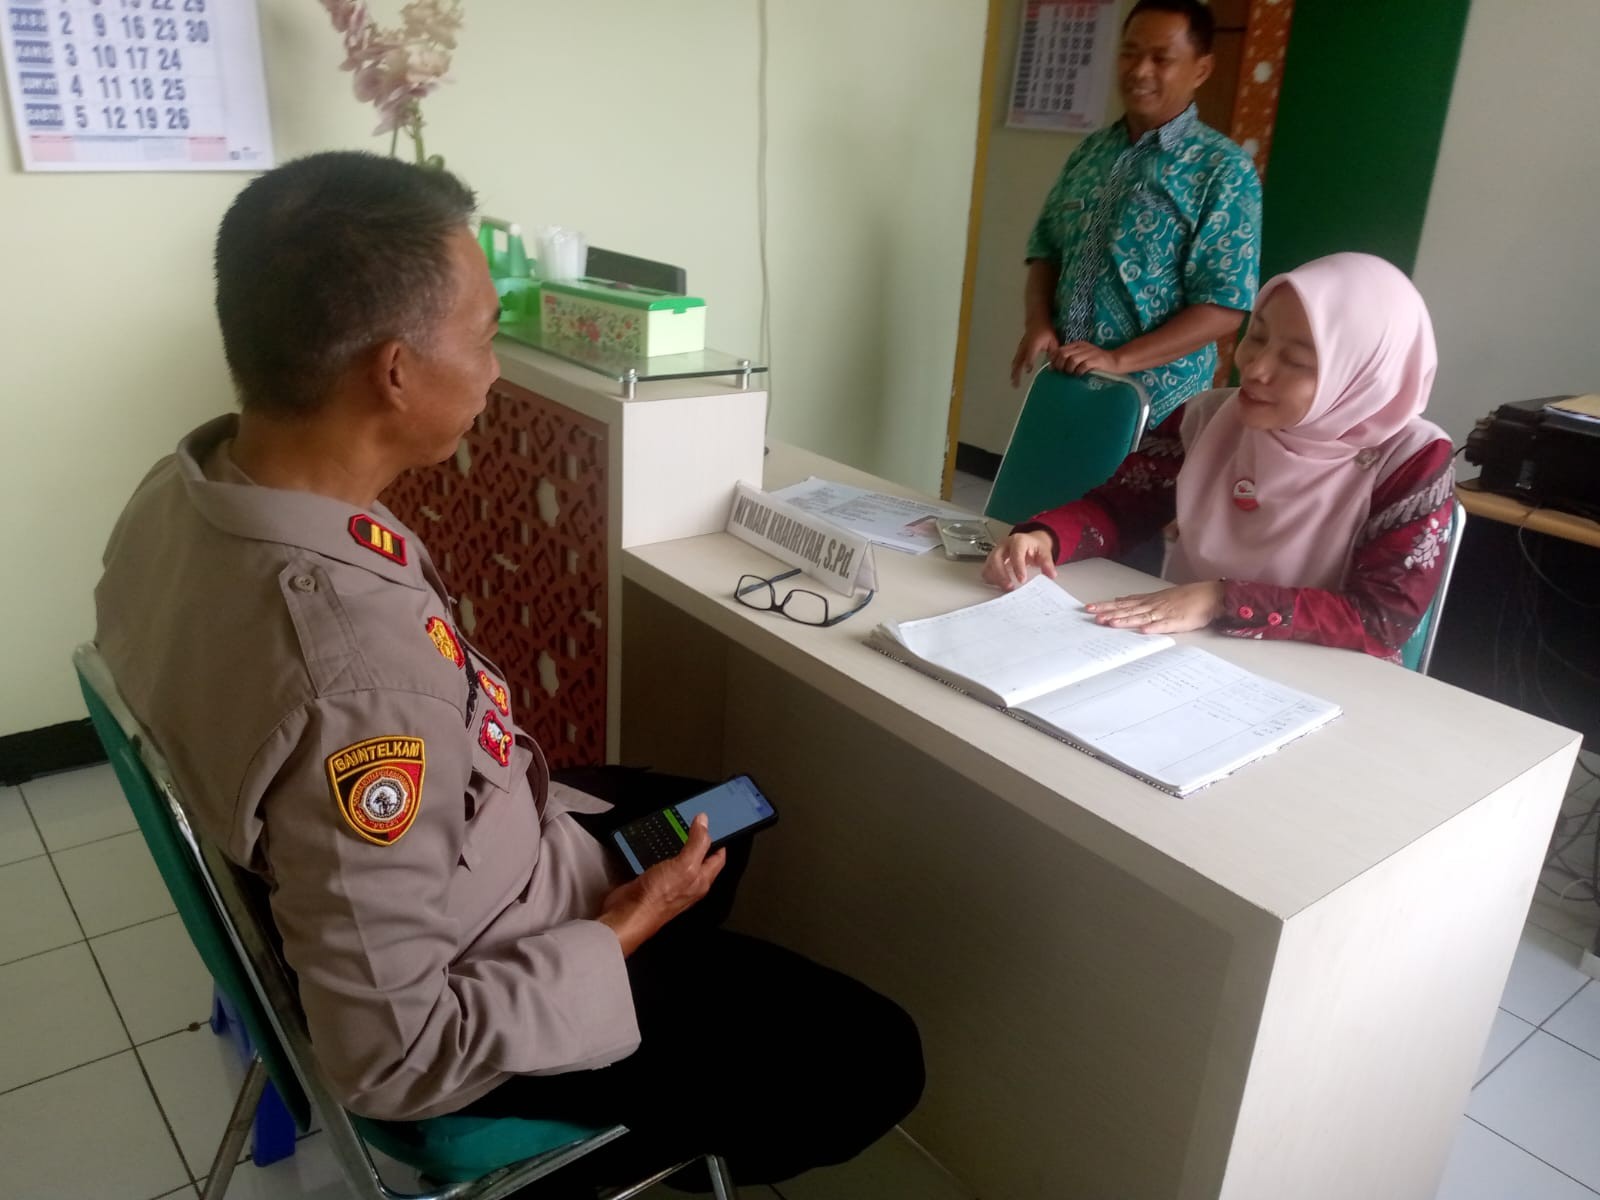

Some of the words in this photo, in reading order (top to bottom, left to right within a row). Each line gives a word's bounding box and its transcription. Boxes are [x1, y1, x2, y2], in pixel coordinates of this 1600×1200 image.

[59, 11, 72, 35] 2
[93, 13, 106, 37] 9
[121, 15, 145, 39] 16
[153, 17, 178, 41] 23
[185, 19, 209, 42] 30
[65, 43, 78, 66] 3
[92, 45, 117, 68] 10
[126, 46, 148, 70] 17
[158, 48, 182, 70] 24
[71, 74, 83, 98] 4
[99, 75, 122, 99] 11
[131, 77, 154, 100] 18
[162, 78, 187, 101] 25
[75, 105, 88, 128] 5
[102, 106, 127, 129] 12
[135, 107, 158, 129] 19
[165, 107, 190, 130] 26
[823, 539, 855, 579] S.Pd.
